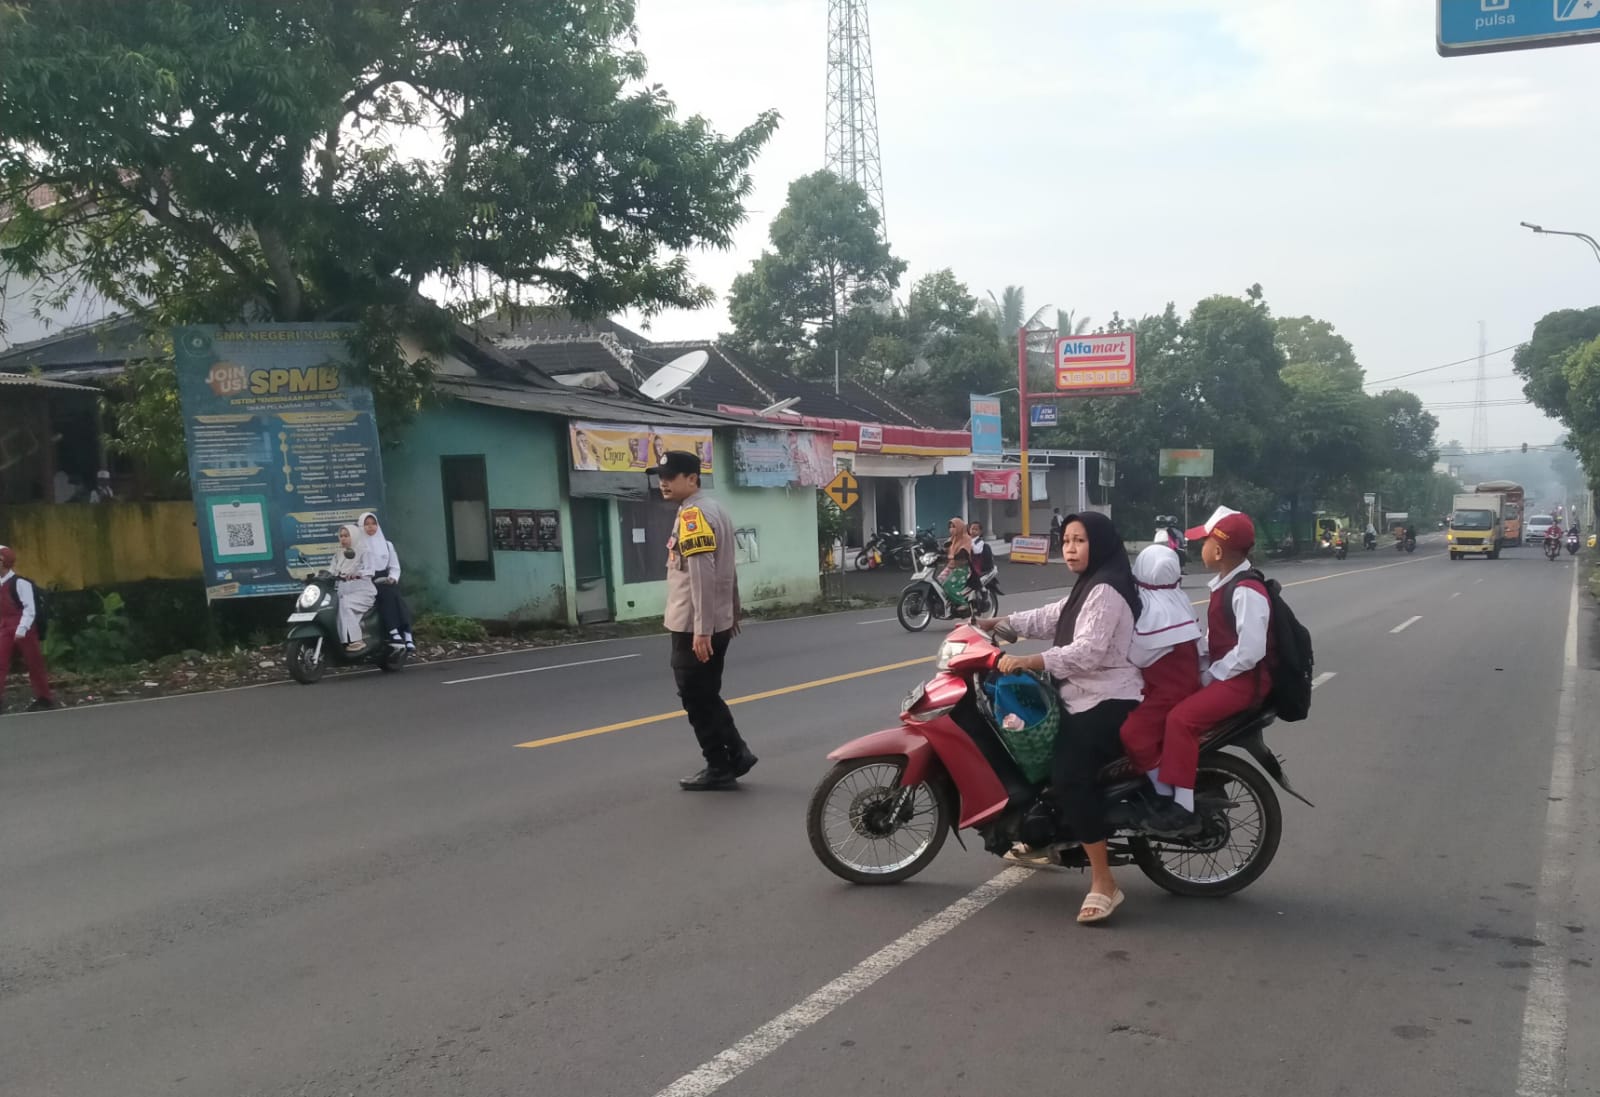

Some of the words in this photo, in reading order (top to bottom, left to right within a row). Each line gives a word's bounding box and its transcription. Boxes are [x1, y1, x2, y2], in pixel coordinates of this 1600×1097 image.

[1474, 13, 1515, 30] pulsa
[216, 331, 244, 341] SMK
[249, 331, 300, 341] NEGERI
[1064, 341, 1126, 355] Alfamart
[205, 366, 246, 384] JOIN
[250, 367, 340, 395] SPMB
[221, 378, 248, 393] US!
